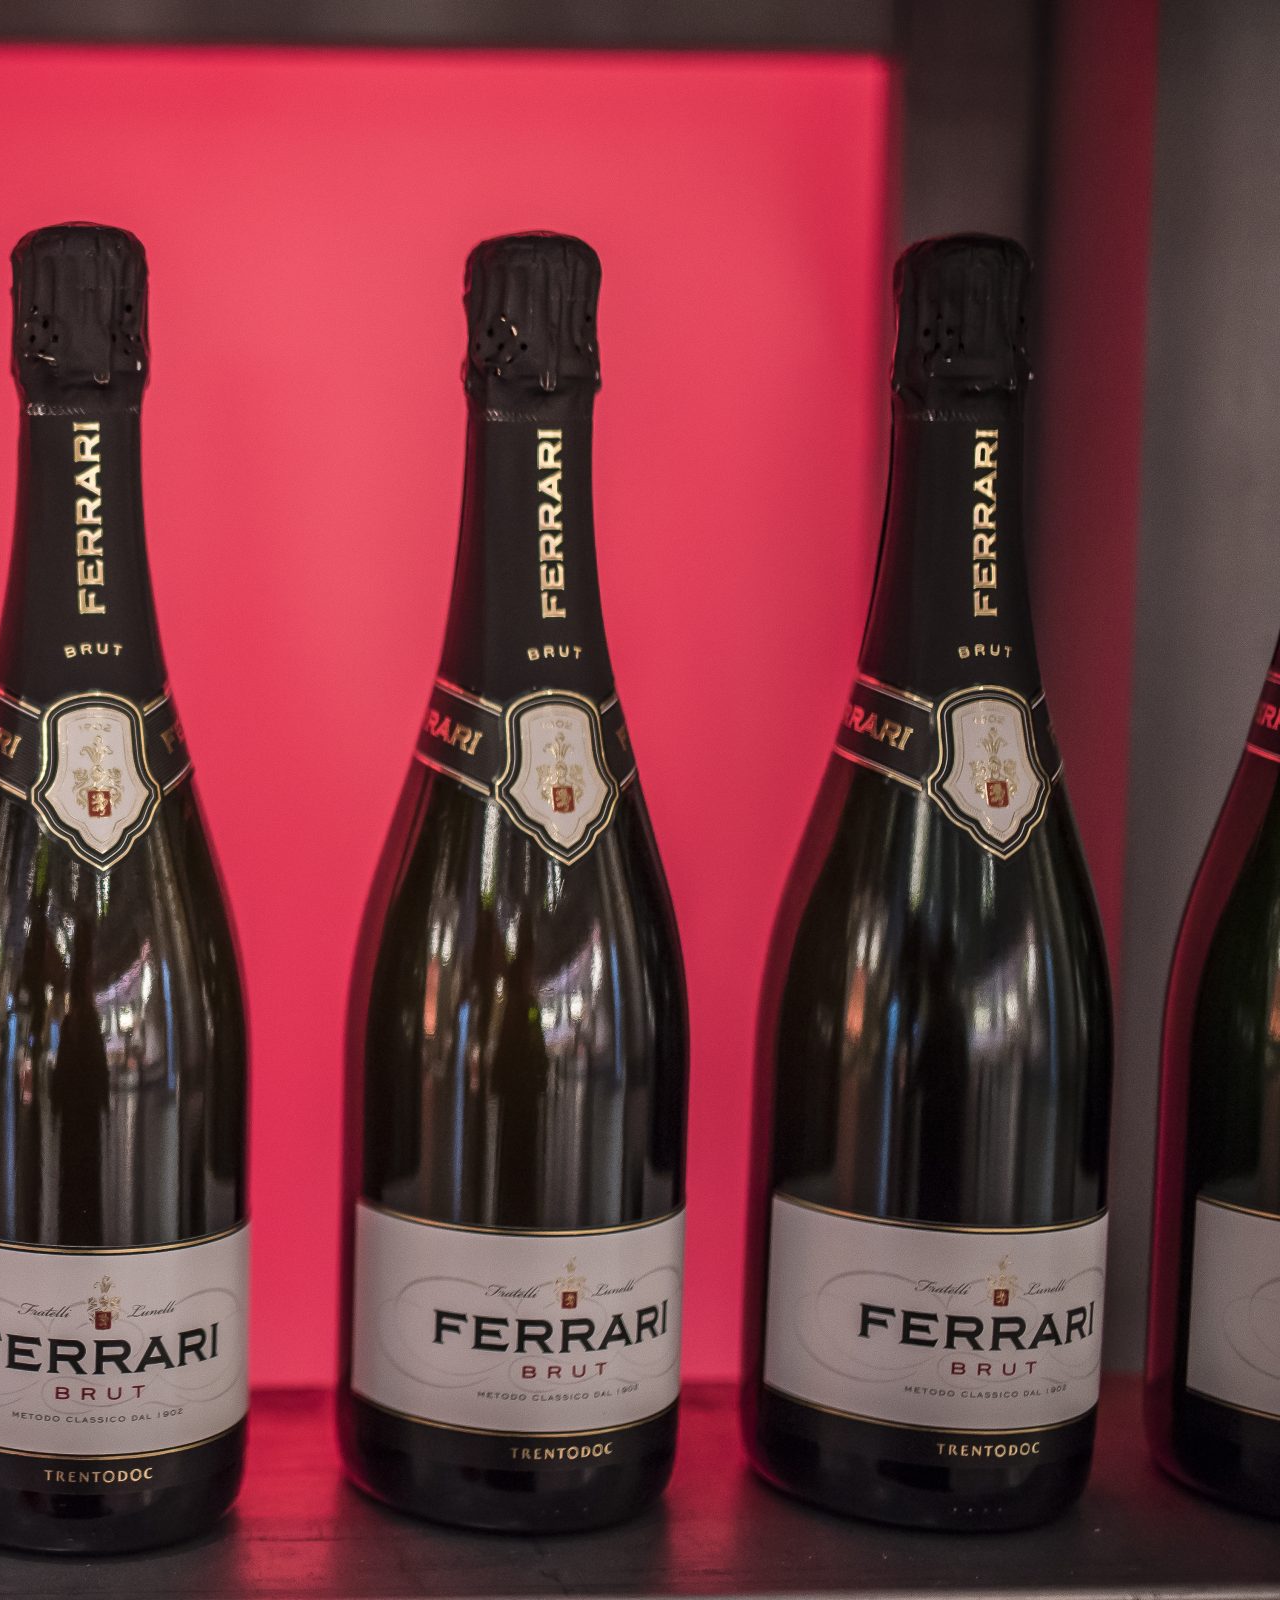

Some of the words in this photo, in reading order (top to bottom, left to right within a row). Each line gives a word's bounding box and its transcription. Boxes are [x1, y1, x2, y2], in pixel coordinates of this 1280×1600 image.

[73, 422, 106, 614] FERRARI
[537, 428, 566, 618] FERRARI
[973, 428, 998, 617] FERRARI
[64, 643, 122, 658] BRUT
[527, 645, 582, 661] BRUT
[958, 644, 1013, 659] BRUT
[485, 1284, 538, 1300] Fratelli
[592, 1280, 635, 1298] Lunelli
[915, 1279, 971, 1296] Fratelli
[1024, 1279, 1066, 1296] Lunelli
[18, 1302, 72, 1319] Fratelli
[127, 1301, 176, 1319] Lunelli
[433, 1300, 669, 1353] FERRARI
[858, 1301, 1095, 1351] FERRARI
[521, 1362, 608, 1380] BRUT
[951, 1361, 1037, 1376] BRUT
[55, 1385, 146, 1401] BRUT
[532, 1392, 589, 1402] CLASSICO
[594, 1390, 612, 1398] DAL
[905, 1385, 955, 1397] METODO
[961, 1391, 1019, 1399] CLASSICO
[1024, 1389, 1041, 1397] DAL
[1046, 1384, 1066, 1394] 1902
[12, 1411, 61, 1422] METODO
[131, 1413, 151, 1421] DAL
[157, 1408, 184, 1418] 1902
[511, 1442, 613, 1460] TRENTODOC
[936, 1442, 1040, 1458] TRENTODOC
[44, 1467, 153, 1483] TRENTODOC
